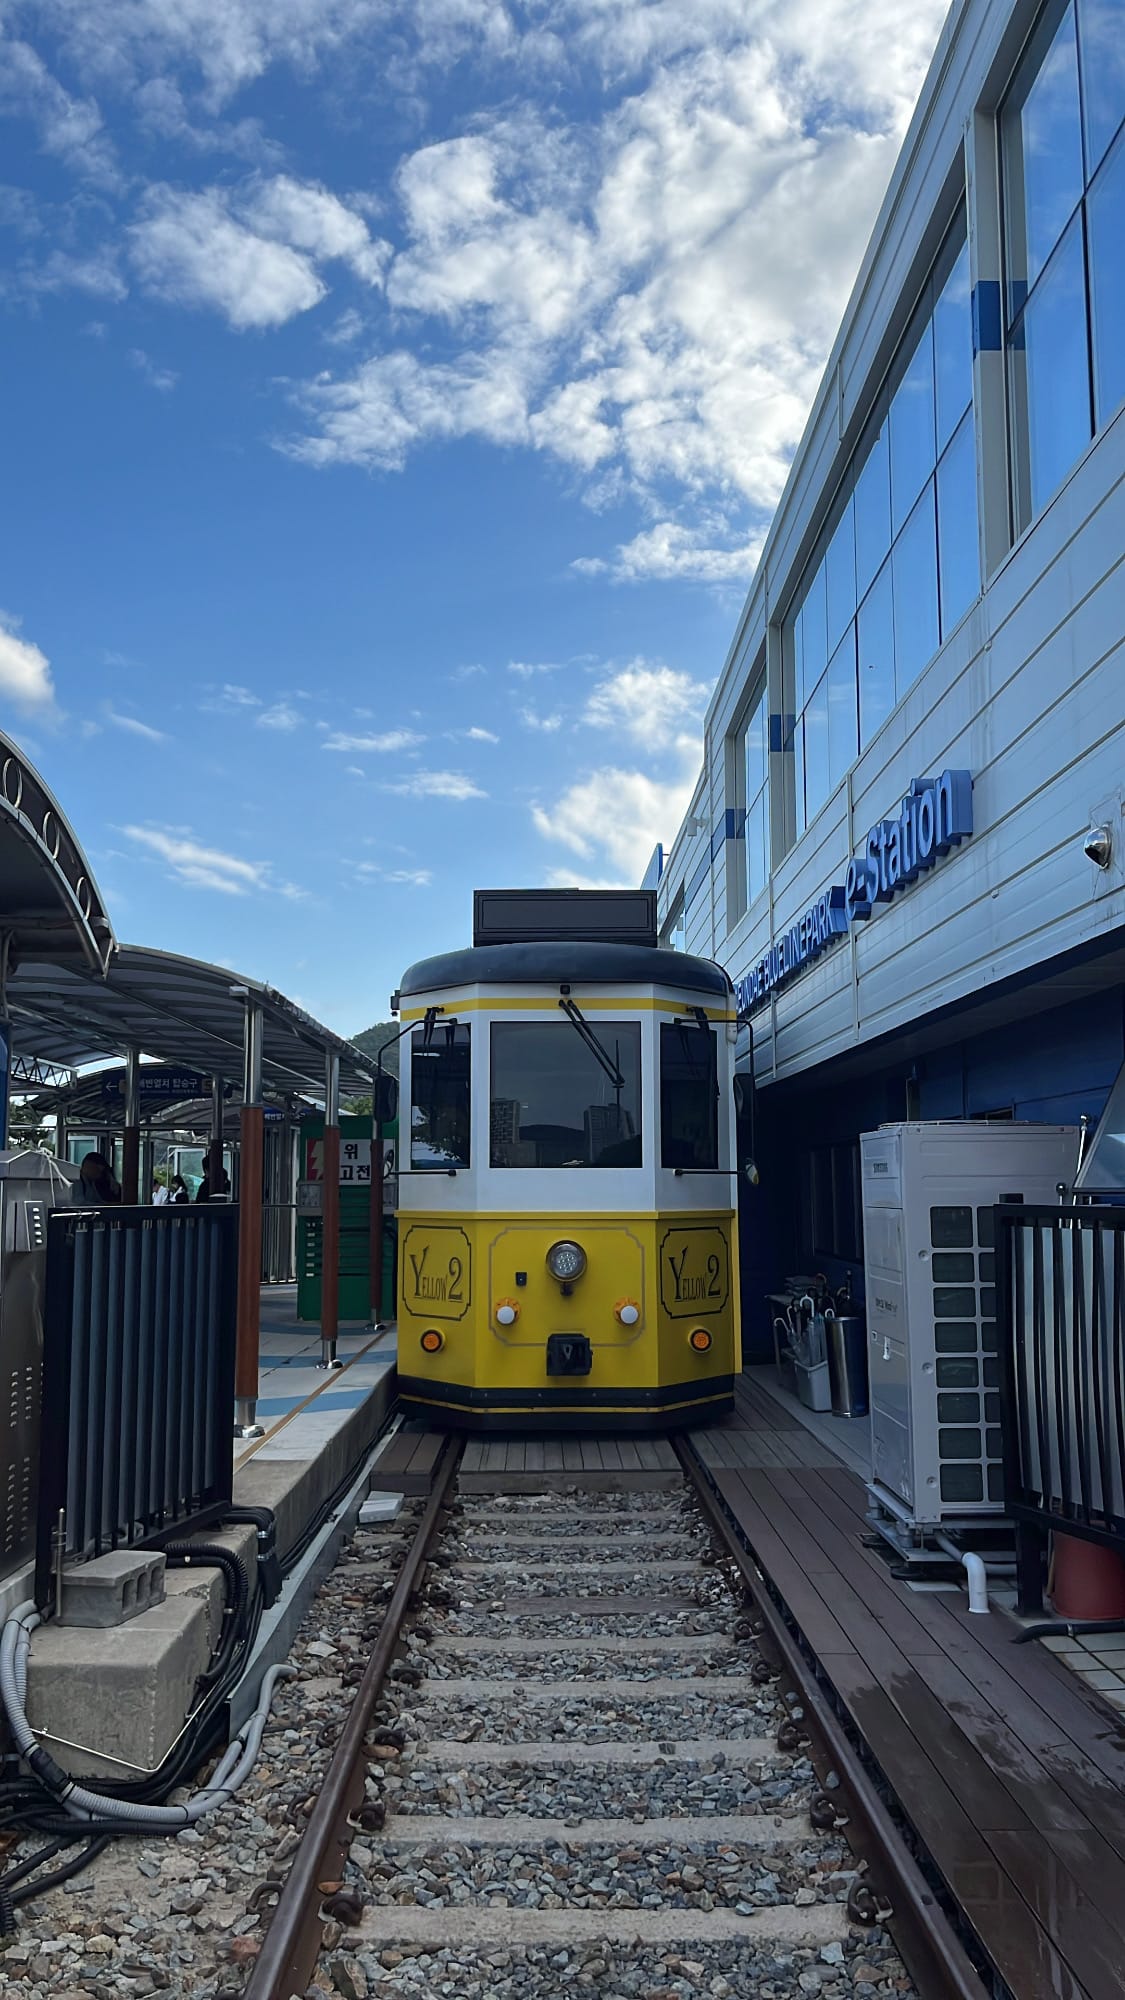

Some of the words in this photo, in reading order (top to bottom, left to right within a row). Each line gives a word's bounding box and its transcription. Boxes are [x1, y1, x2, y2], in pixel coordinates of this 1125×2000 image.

[735, 960, 764, 1013] EUNDAE
[845, 769, 969, 921] e-Station
[340, 1165, 370, 1180] 고전
[344, 1144, 358, 1159] 위
[409, 1245, 448, 1301] YELLOW
[448, 1257, 463, 1301] 2
[668, 1246, 706, 1301] YELLOW
[707, 1255, 721, 1297] 2
